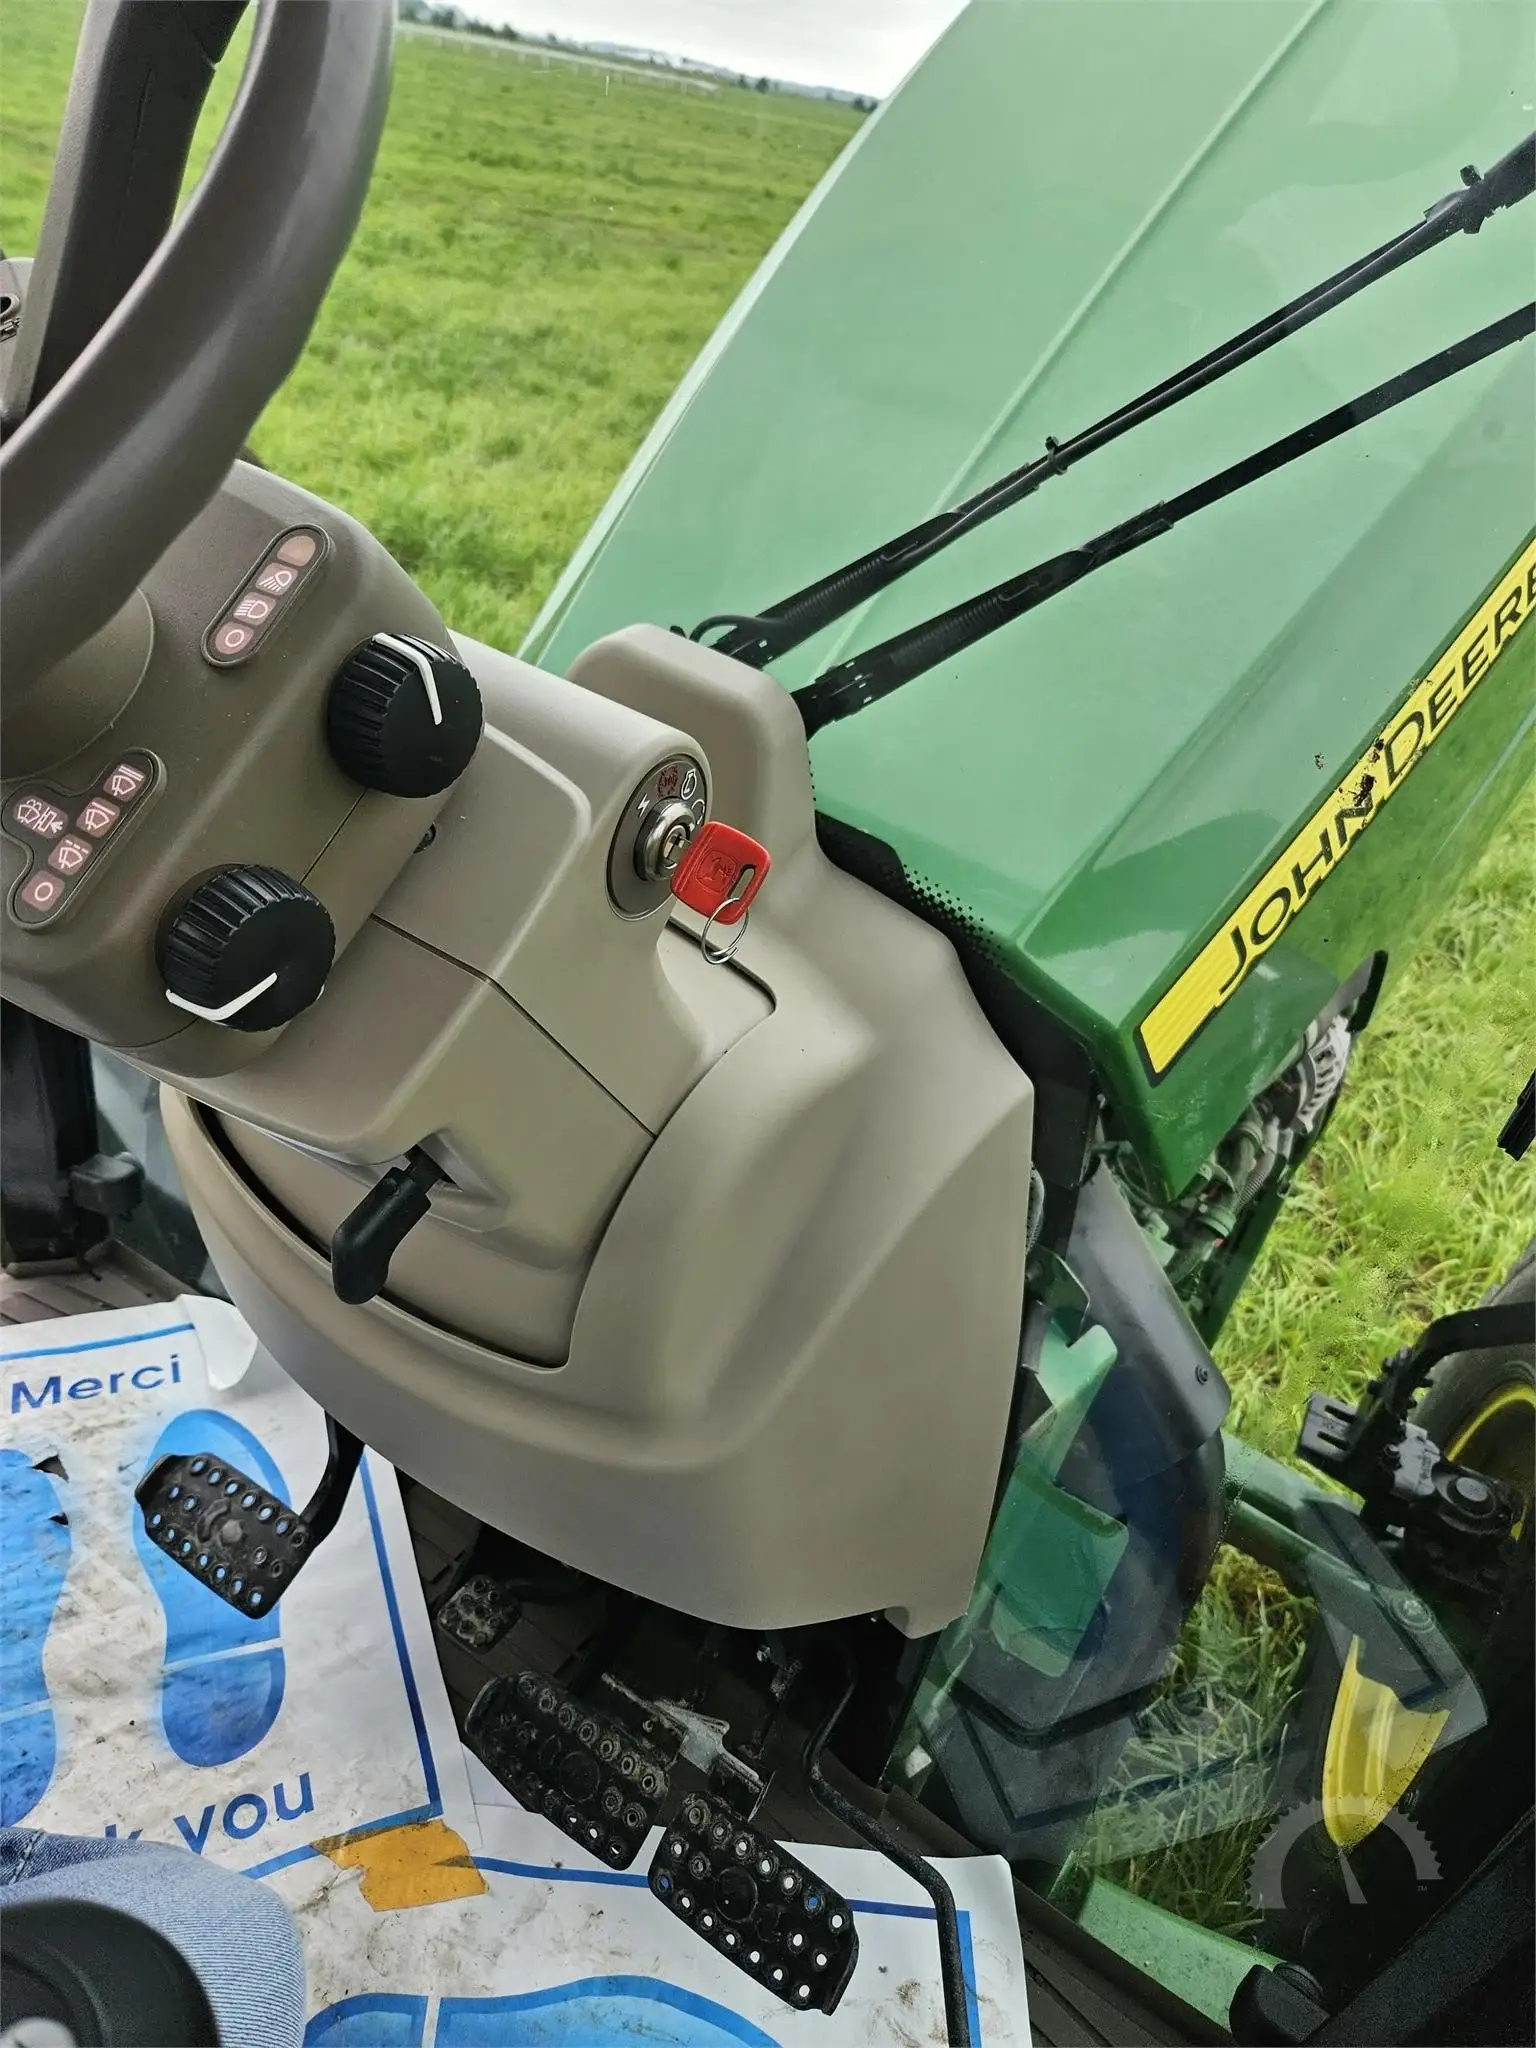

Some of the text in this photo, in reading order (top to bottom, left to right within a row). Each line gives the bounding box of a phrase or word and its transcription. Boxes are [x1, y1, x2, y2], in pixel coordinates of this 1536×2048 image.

[1219, 773, 1373, 995] JOHN
[11, 1354, 182, 1414] Merci
[173, 1771, 314, 1855] you
